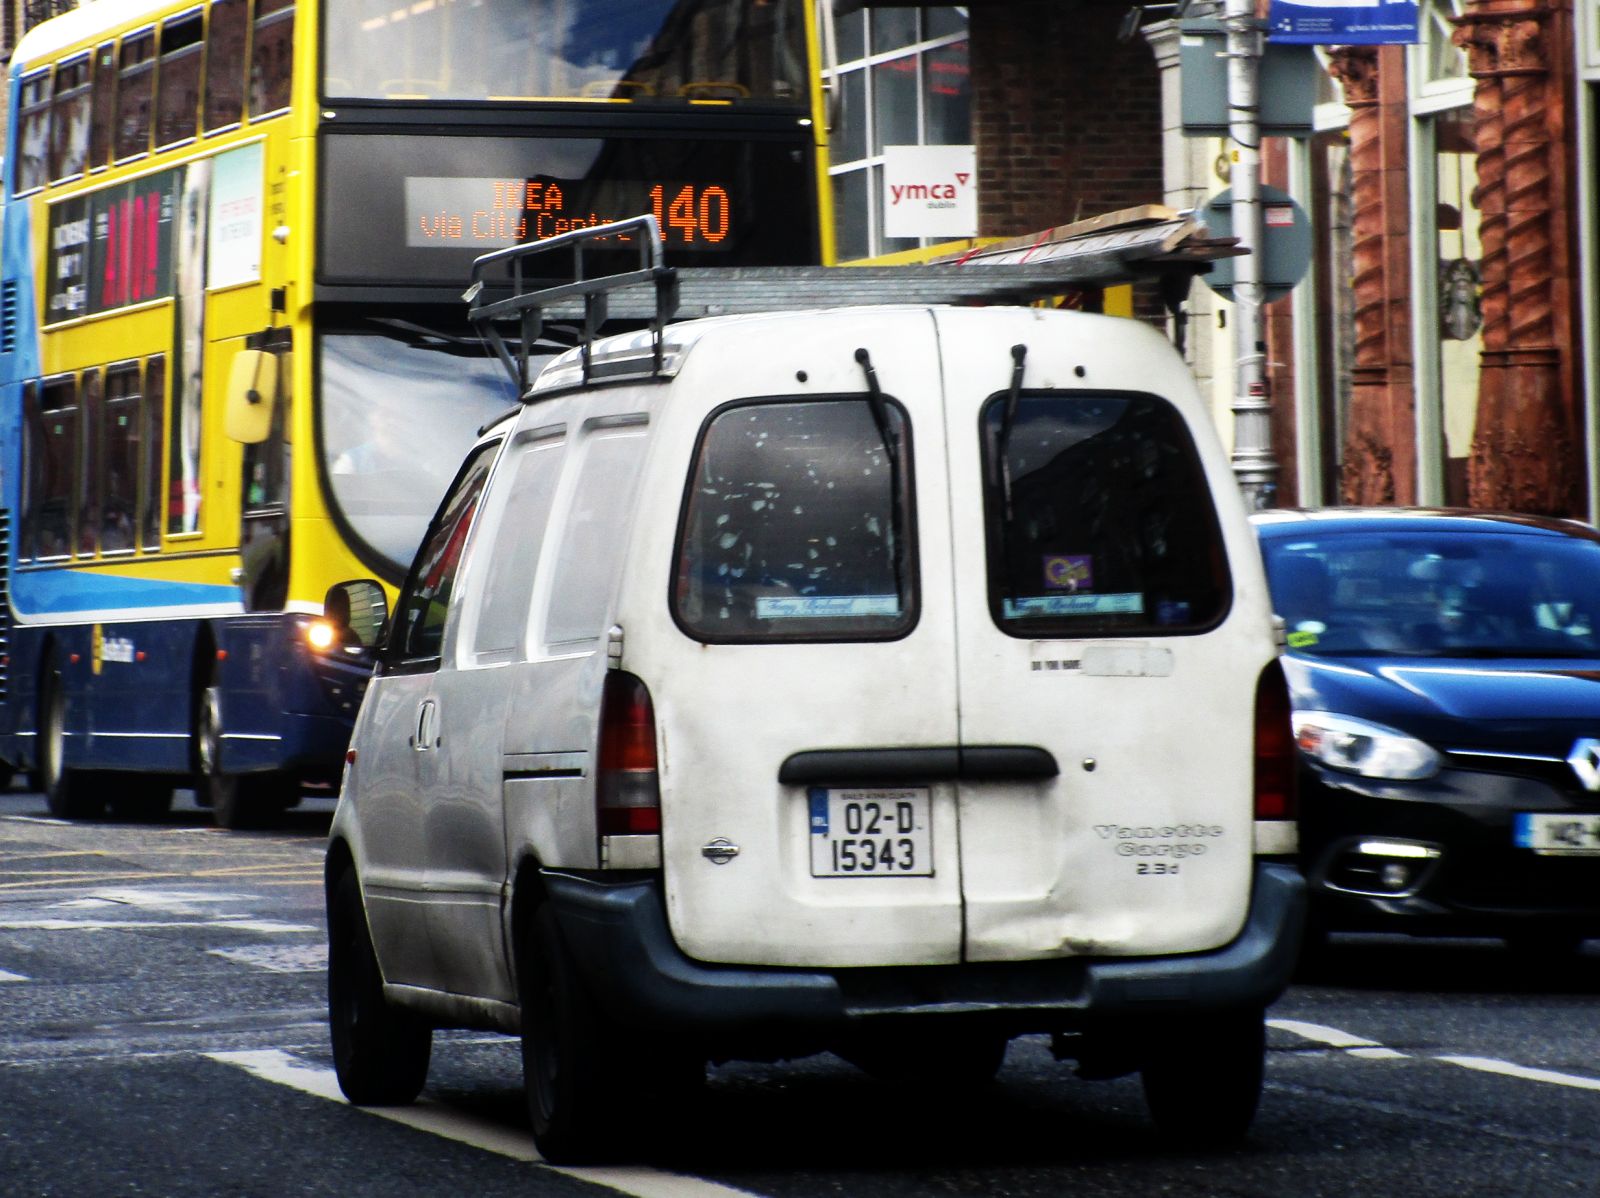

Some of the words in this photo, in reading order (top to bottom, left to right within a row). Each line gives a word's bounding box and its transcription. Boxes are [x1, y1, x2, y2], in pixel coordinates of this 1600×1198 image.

[492, 181, 563, 210] IKEA
[890, 184, 956, 205] ymca
[421, 209, 462, 238] via
[472, 209, 526, 239] City
[649, 184, 729, 242] 140
[845, 802, 914, 834] 02-D
[832, 838, 914, 871] 15343
